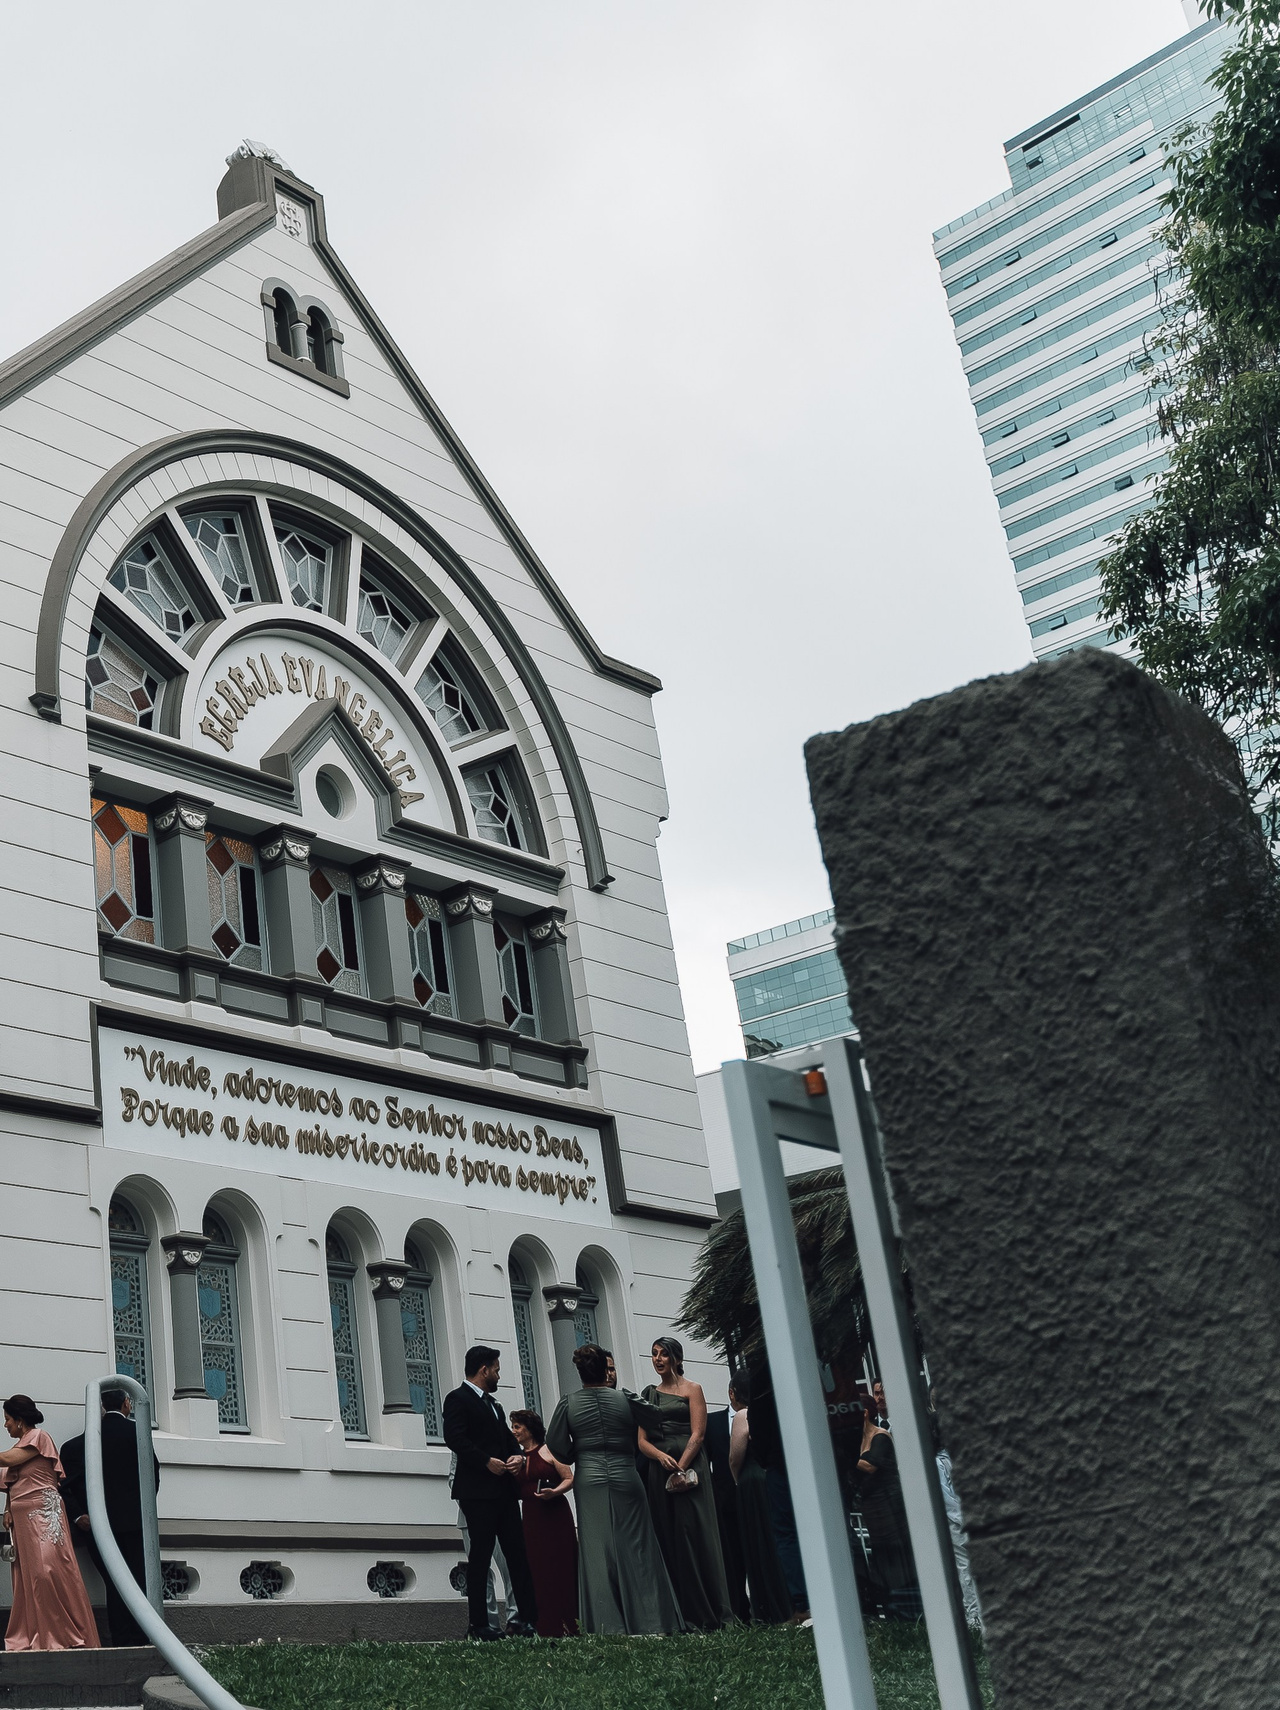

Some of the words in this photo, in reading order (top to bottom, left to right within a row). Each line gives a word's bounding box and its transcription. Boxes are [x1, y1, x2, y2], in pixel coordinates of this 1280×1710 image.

[281, 652, 425, 808] EVANGELICA
[120, 1086, 215, 1139] Porque
[220, 1115, 240, 1142] a
[242, 1114, 290, 1150] sua
[294, 1123, 441, 1176] misericordia
[445, 1147, 458, 1179] é
[460, 1154, 512, 1187] para
[223, 1067, 344, 1118] adoremos
[349, 1096, 381, 1125] ao
[384, 1095, 468, 1142] Senhor
[472, 1120, 532, 1154] nosso
[533, 1124, 589, 1170] Deus,
